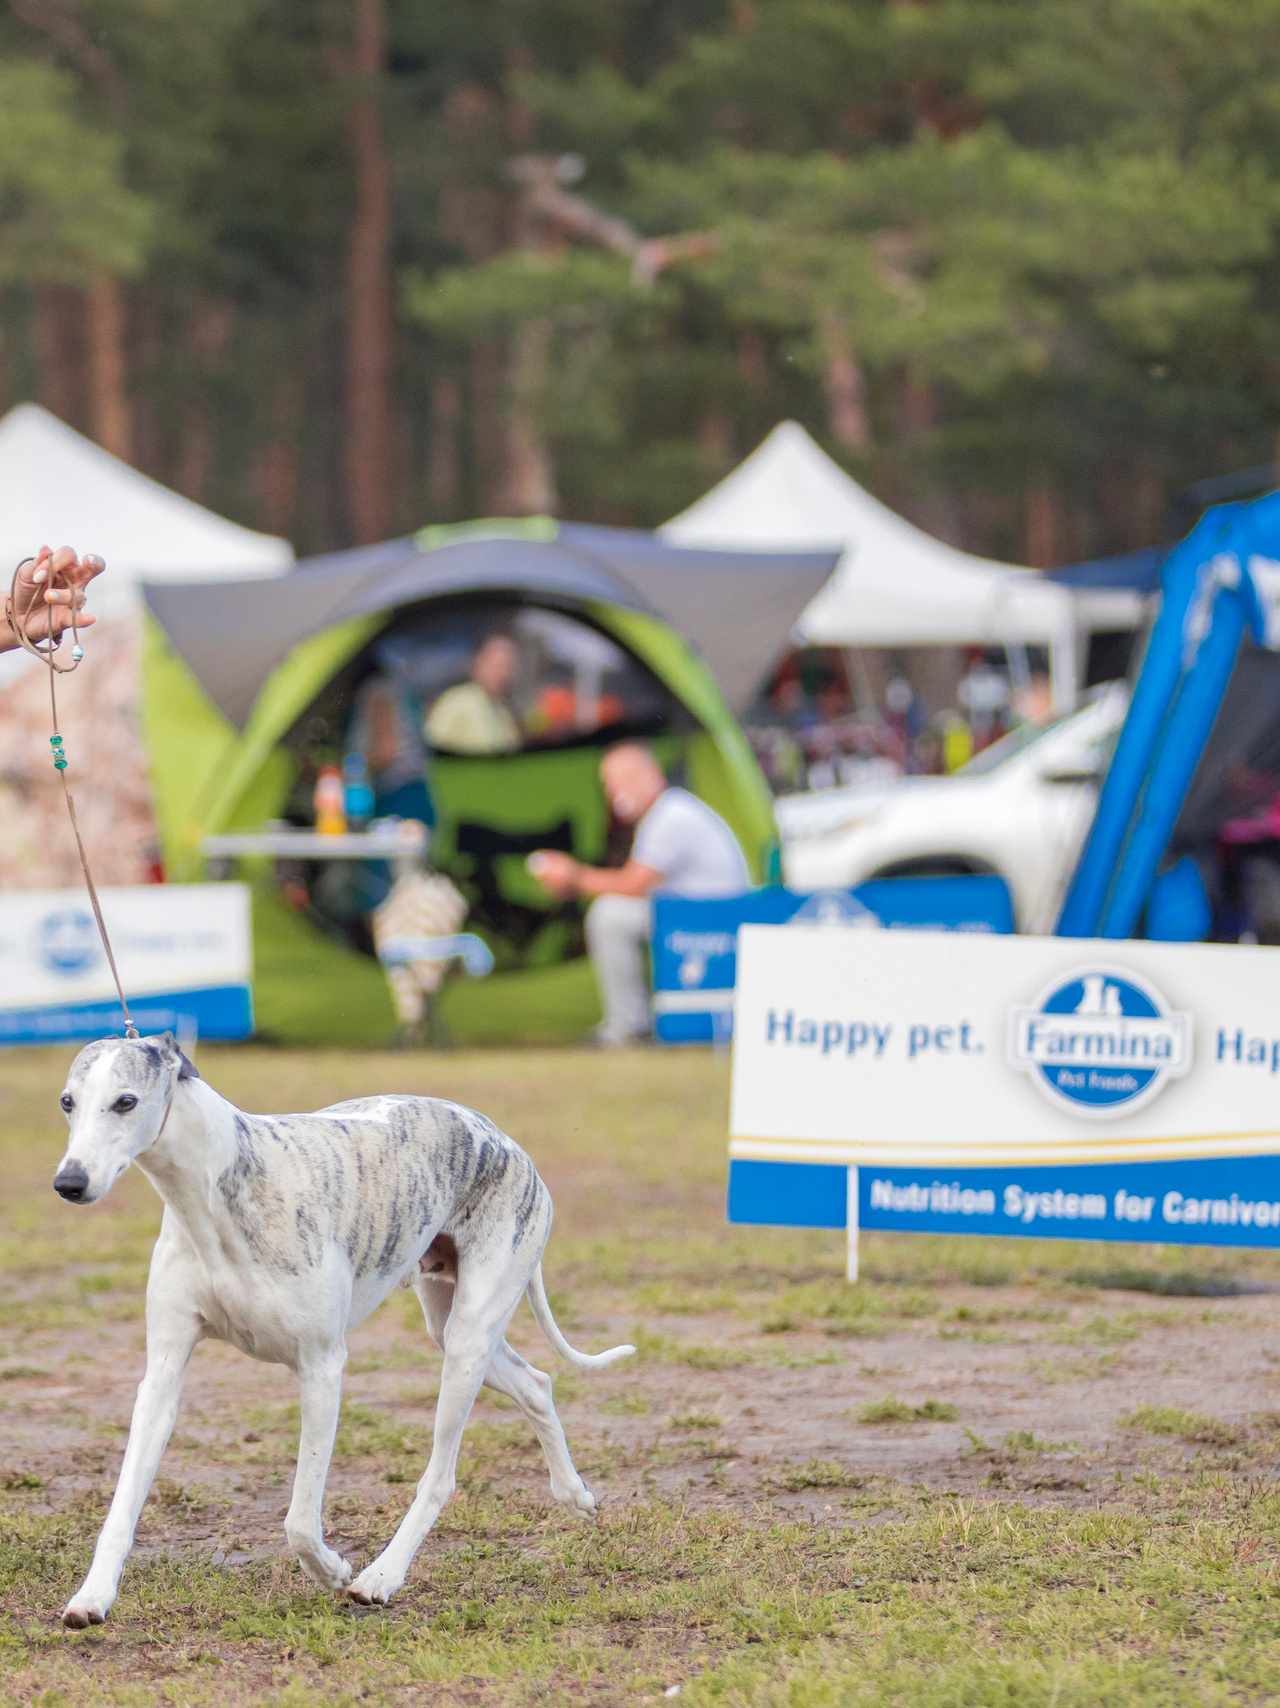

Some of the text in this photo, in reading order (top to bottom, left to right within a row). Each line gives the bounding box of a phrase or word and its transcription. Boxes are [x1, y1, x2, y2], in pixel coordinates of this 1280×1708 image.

[766, 1008, 985, 1061] Happy pet.
[1026, 1018, 1173, 1059] Farmina
[871, 1179, 996, 1215] Nutrition
[1003, 1184, 1107, 1224] System
[1114, 1189, 1156, 1222] for
